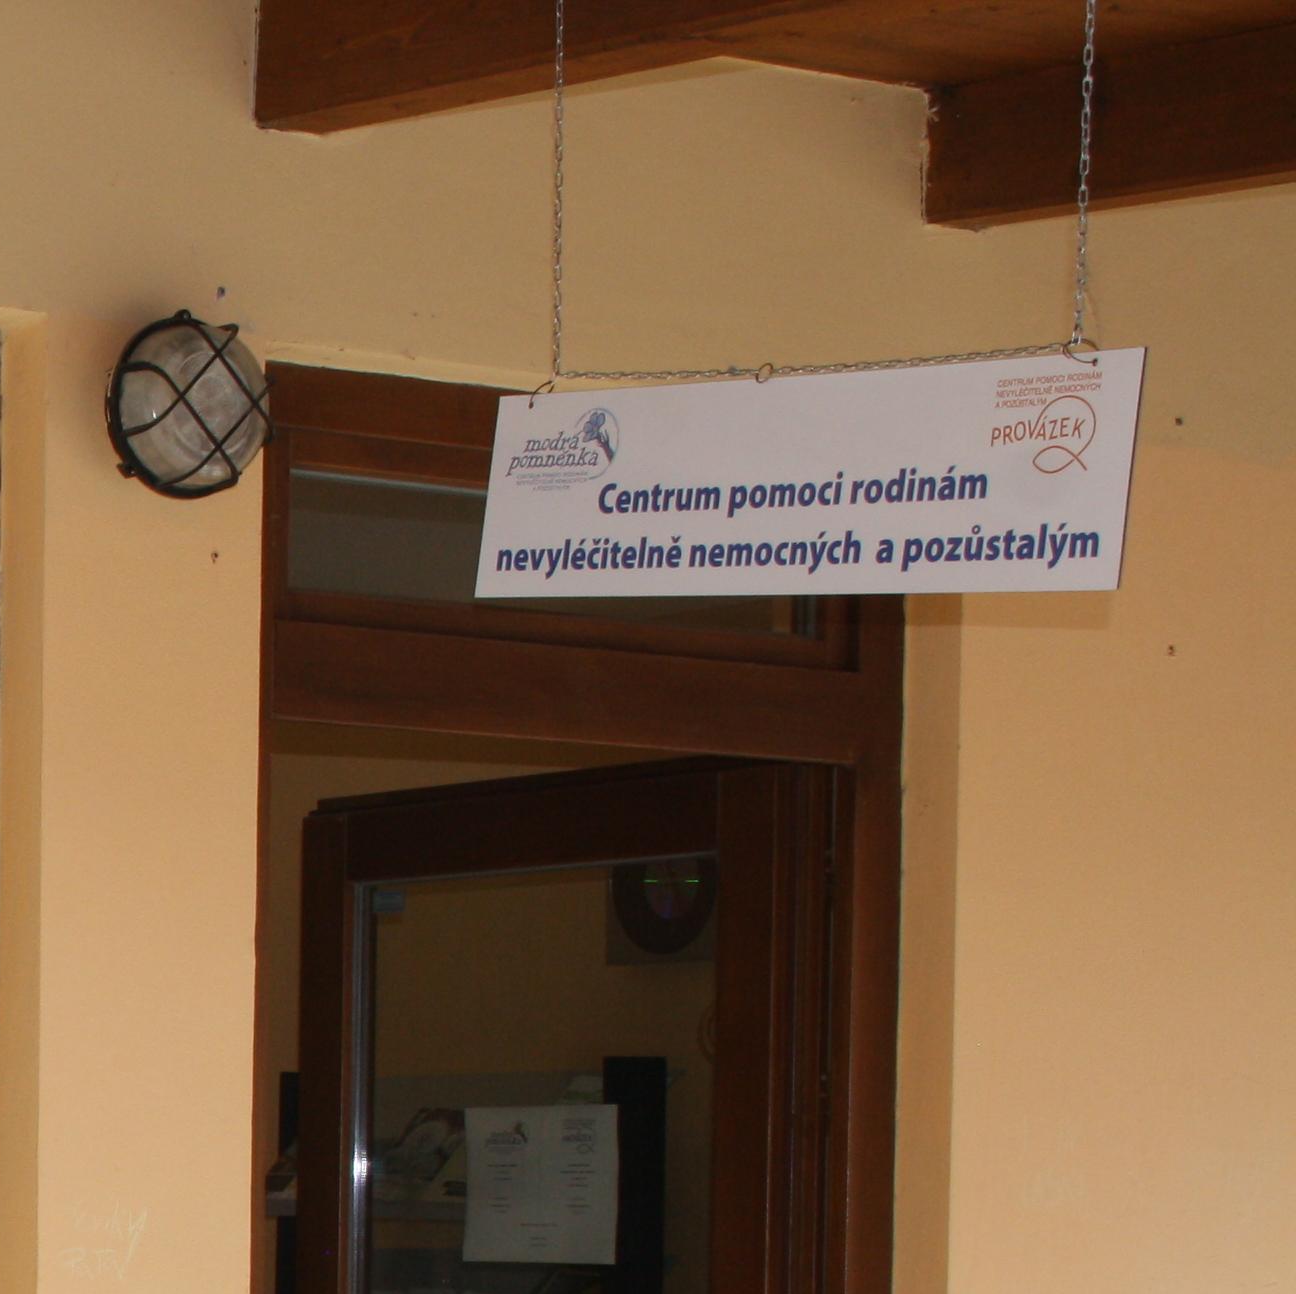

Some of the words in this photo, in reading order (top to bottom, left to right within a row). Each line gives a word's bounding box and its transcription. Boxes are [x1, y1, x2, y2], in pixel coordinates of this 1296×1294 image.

[523, 430, 586, 452] modrá
[990, 416, 1086, 448] PROVÁZEK
[505, 447, 599, 478] pomněnka
[598, 482, 720, 515] Centrum
[727, 471, 843, 518] pomoci
[850, 464, 988, 505] rodinám
[496, 536, 683, 580] nevyléčitelně
[688, 530, 861, 576] nemocných
[875, 538, 894, 564] a
[900, 522, 1100, 573] pozůstalým
